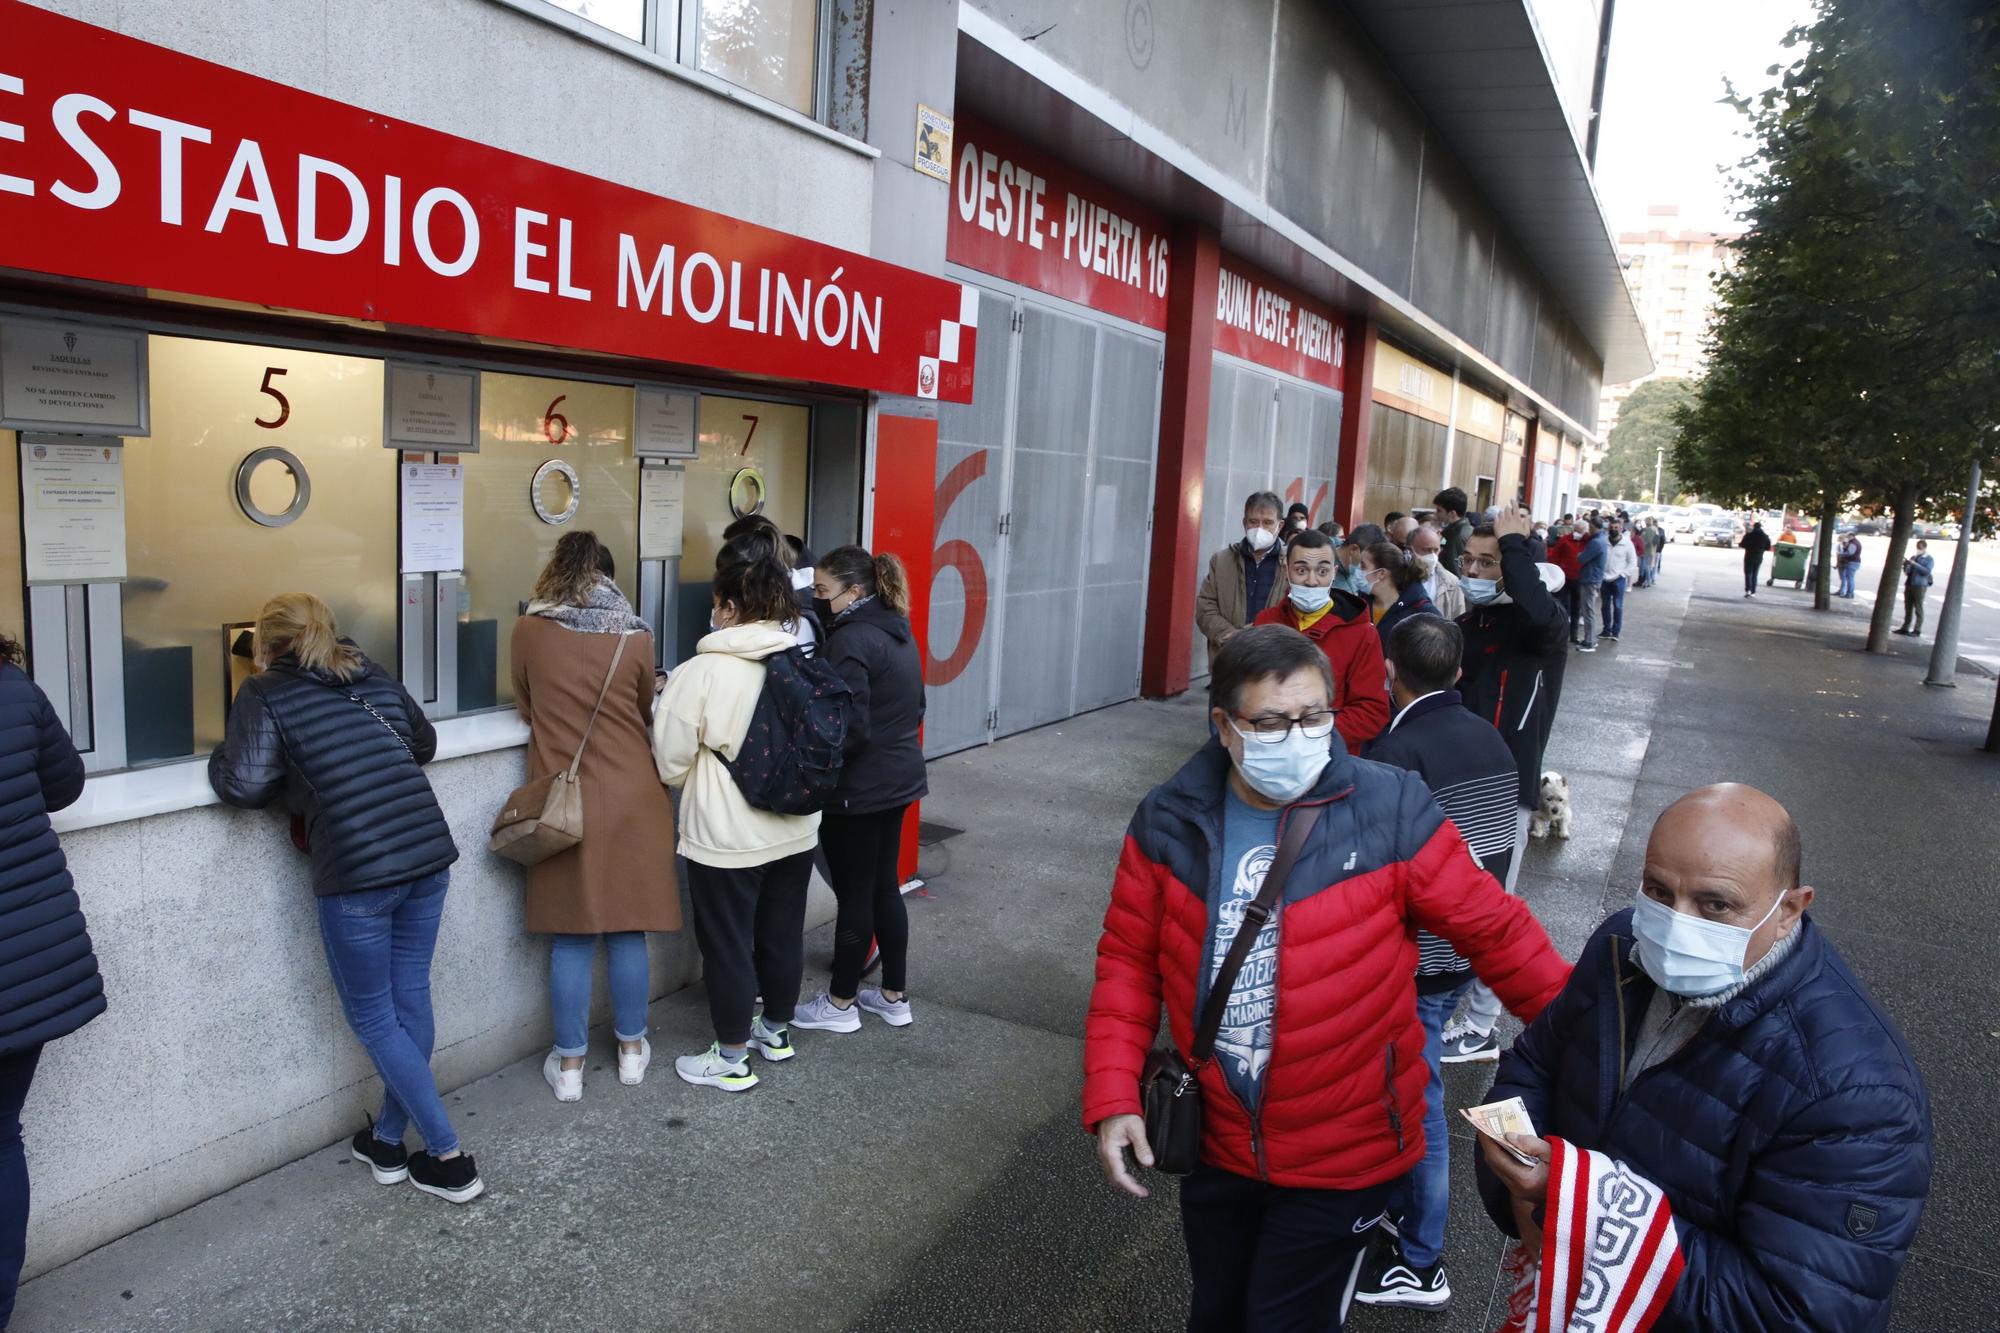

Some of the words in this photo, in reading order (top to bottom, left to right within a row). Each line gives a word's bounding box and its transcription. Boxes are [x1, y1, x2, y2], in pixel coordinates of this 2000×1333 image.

[917, 156, 949, 177] PROSEGUR
[0, 72, 480, 277] ESTADIO
[513, 206, 592, 301] EL
[617, 232, 883, 354] MOLINÓN
[958, 142, 1047, 250] OESTE
[1063, 192, 1142, 288] PUERTA
[1147, 233, 1169, 299] 16
[1254, 286, 1291, 348] OESTE
[1295, 307, 1332, 364] PUERTA
[1333, 325, 1344, 369] 16
[254, 366, 290, 429] 5
[544, 394, 569, 445] 6
[741, 414, 759, 456] 7
